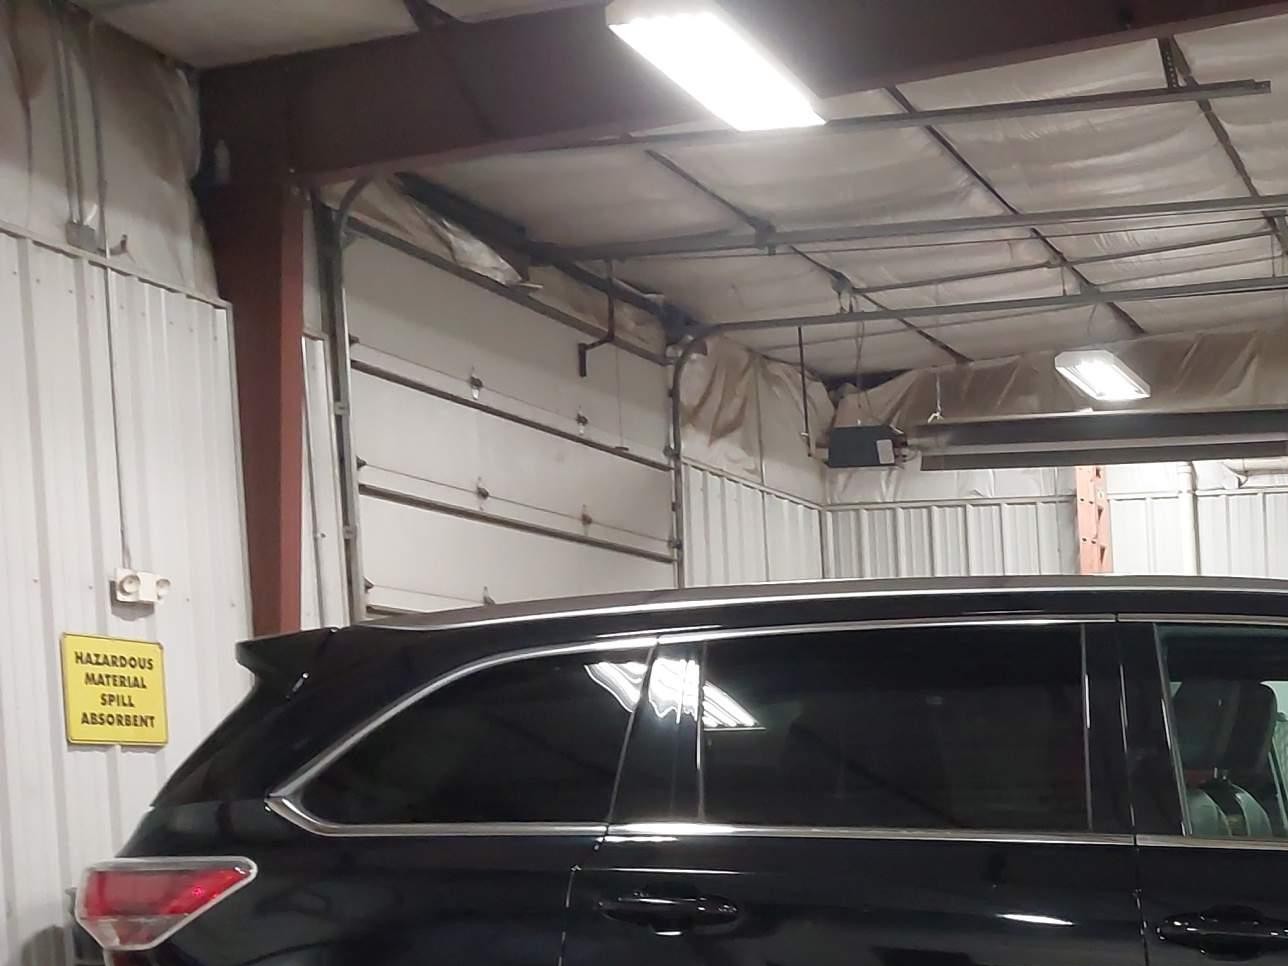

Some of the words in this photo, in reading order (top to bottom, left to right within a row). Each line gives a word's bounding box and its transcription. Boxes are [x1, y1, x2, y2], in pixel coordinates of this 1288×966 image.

[74, 651, 153, 670] HAZARDOUS
[84, 672, 147, 689] MATERIAL
[100, 693, 135, 707] SPILL
[80, 711, 155, 728] ABSORBENT
